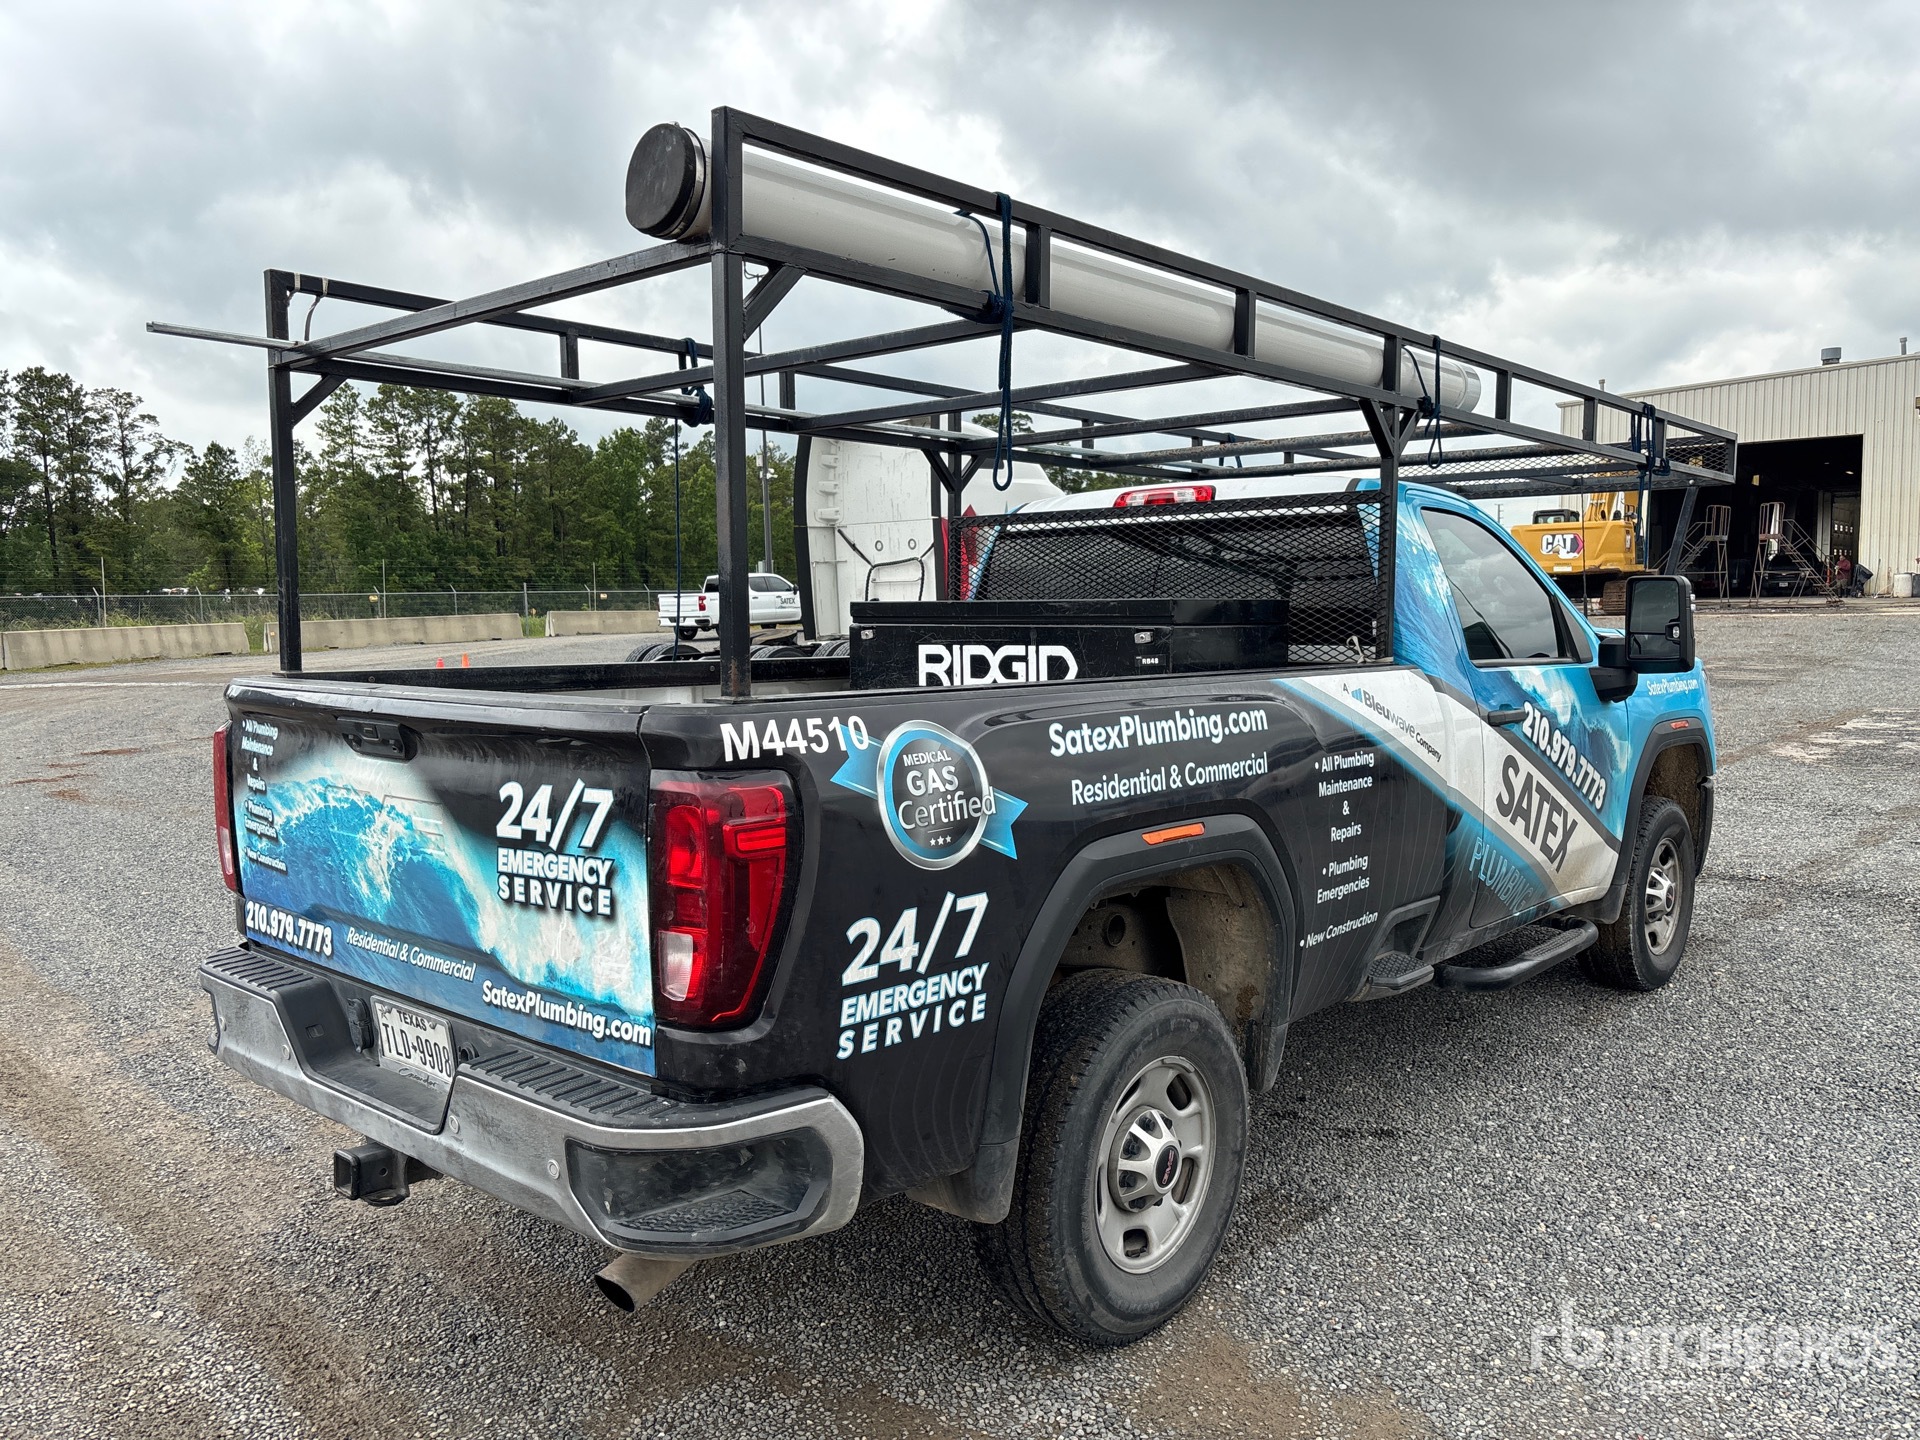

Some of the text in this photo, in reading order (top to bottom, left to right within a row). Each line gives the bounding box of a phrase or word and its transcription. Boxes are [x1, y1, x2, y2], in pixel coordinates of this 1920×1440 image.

[1541, 534, 1574, 554] CAT
[918, 644, 1078, 687] RIDGID
[719, 715, 869, 762] M44510
[1048, 708, 1269, 757] SatexPlumbing.com
[1342, 683, 1442, 762] A Bleuwave Company
[902, 749, 952, 767] MEDICAL
[1321, 752, 1375, 773] All Plumbing
[1522, 701, 1607, 810] 210.979.7773
[906, 765, 959, 796] GAS
[1071, 751, 1268, 805] Residential & Commercial
[1318, 775, 1373, 797] Maintenance
[496, 778, 614, 851] 24/7
[898, 786, 996, 830] Certified
[1342, 800, 1350, 816] &
[1495, 755, 1579, 874] SATEX
[1330, 822, 1362, 843] Repairs
[497, 847, 614, 886] EMERGENCY
[1328, 855, 1369, 878] Plumbing
[1468, 836, 1534, 914] PLUMBING
[498, 875, 613, 916] SERVICE
[1316, 876, 1370, 904] Emergencies
[245, 900, 332, 957] 210.979.7773
[841, 891, 989, 987] 24/7
[1305, 911, 1379, 949] New Construction
[346, 926, 477, 981] Residential & Commercial
[482, 980, 651, 1046] SatexPlumbing.com
[839, 962, 990, 1028] EMERGENCY
[397, 1010, 428, 1031] TEXAS
[836, 993, 987, 1060] SERVICE
